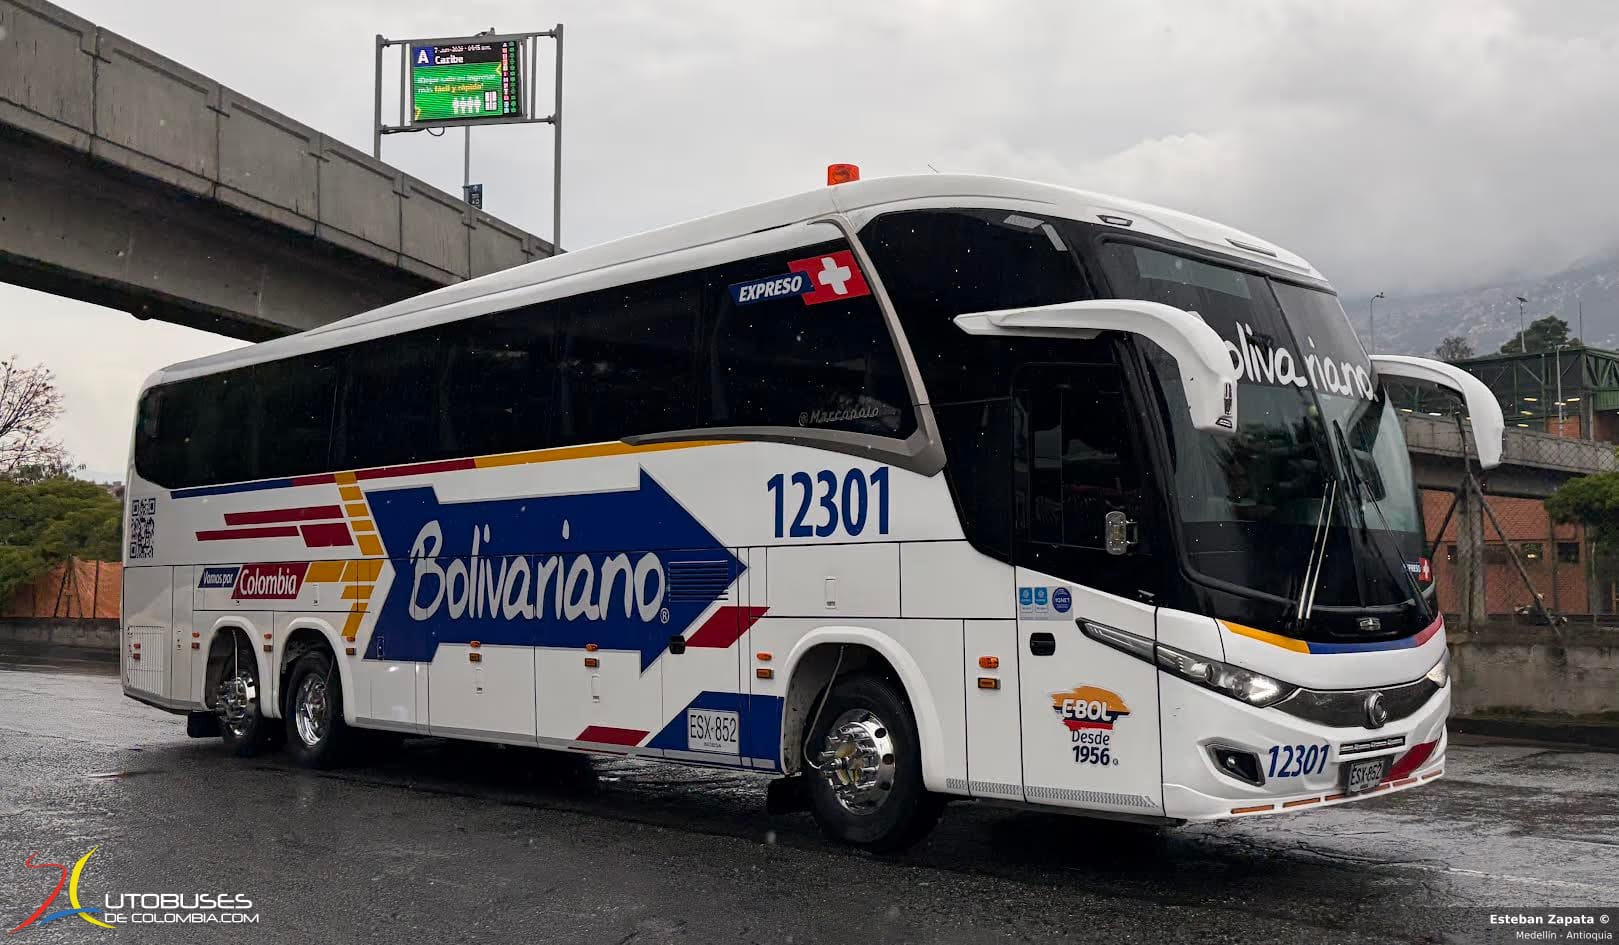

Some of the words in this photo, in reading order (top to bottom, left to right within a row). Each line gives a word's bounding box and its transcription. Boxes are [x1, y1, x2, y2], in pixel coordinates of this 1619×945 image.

[417, 50, 429, 64] A
[434, 55, 464, 65] Caribe
[738, 276, 802, 303] EXPRESO
[767, 466, 889, 538] 12301
[203, 571, 222, 585] Vamos
[222, 573, 233, 587] por
[239, 567, 298, 595] Colombia
[408, 519, 665, 622] Bolivariano
[690, 715, 737, 743] ESX-852
[1072, 730, 1110, 745] Desde
[1072, 745, 1110, 766] 1956
[1268, 744, 1330, 778] 12301
